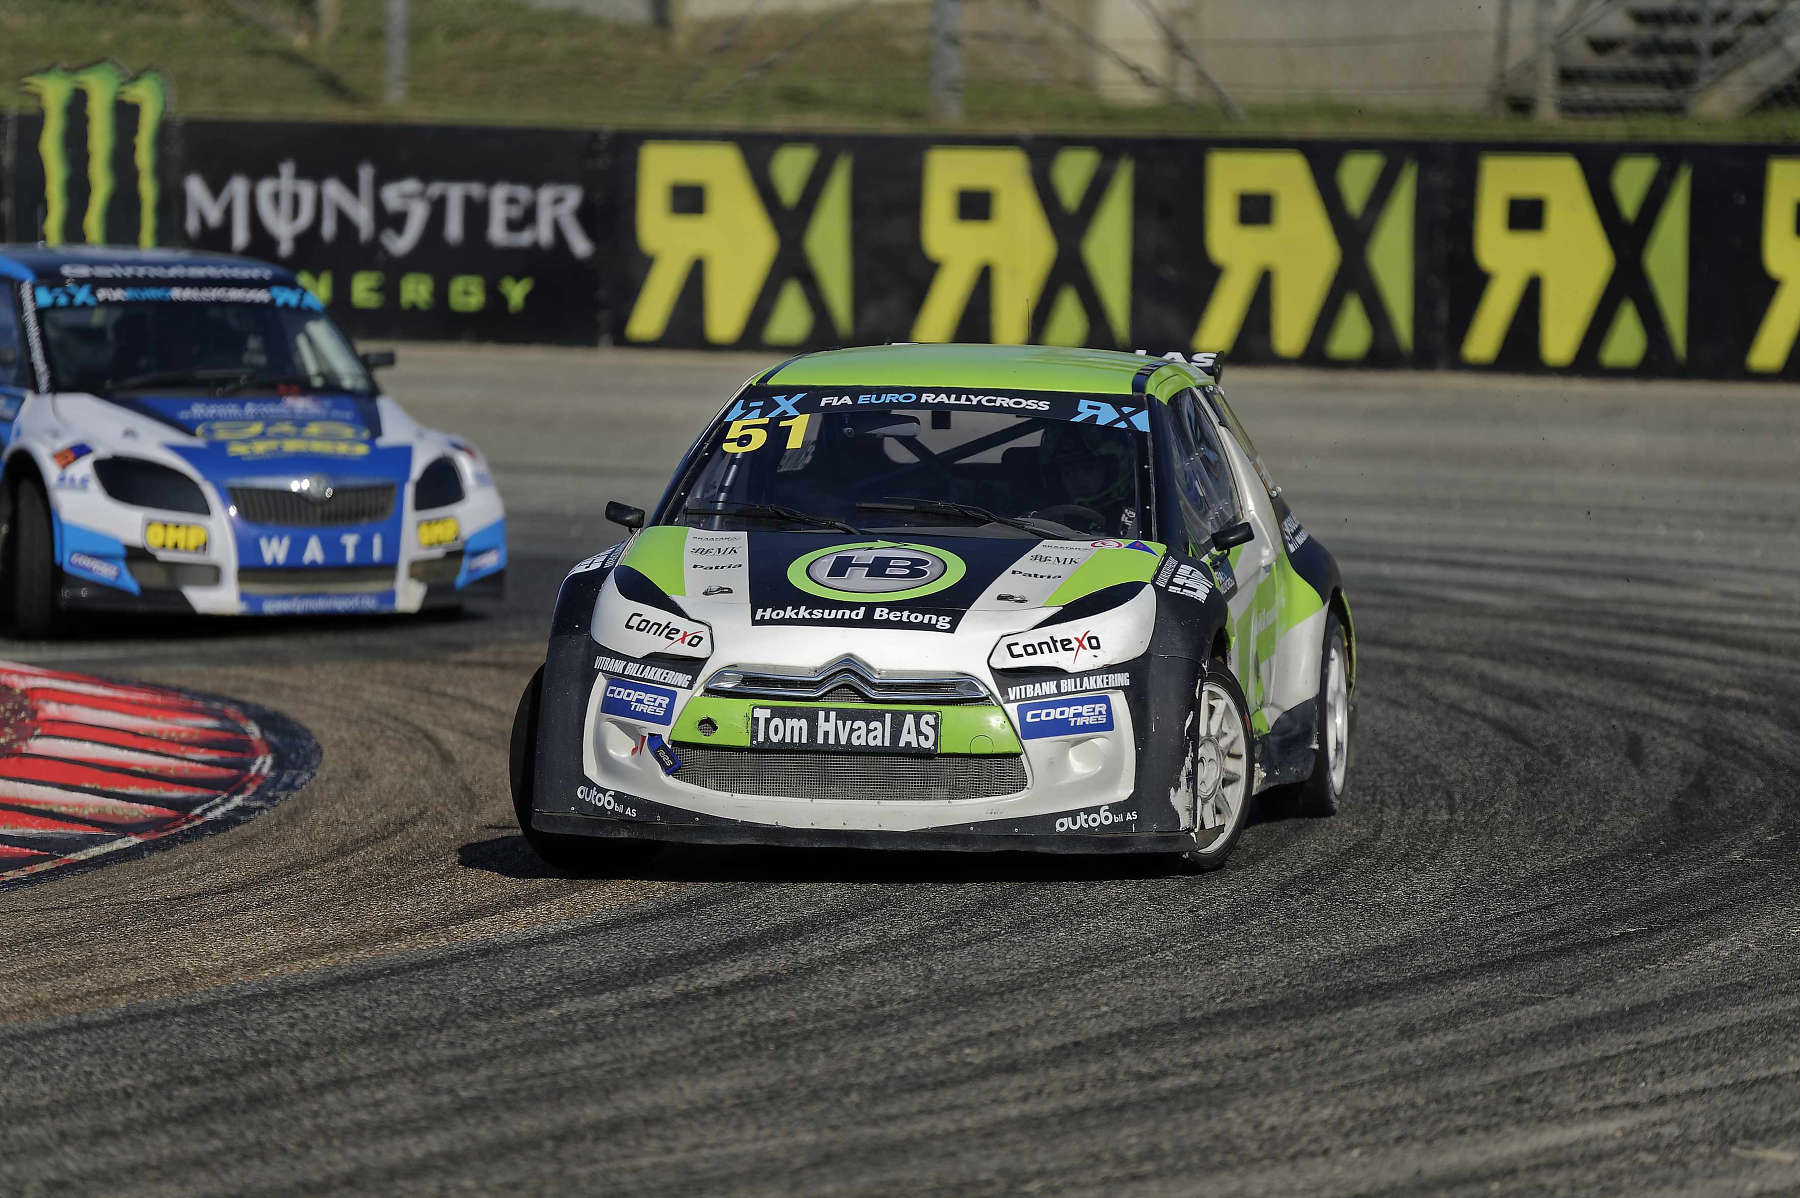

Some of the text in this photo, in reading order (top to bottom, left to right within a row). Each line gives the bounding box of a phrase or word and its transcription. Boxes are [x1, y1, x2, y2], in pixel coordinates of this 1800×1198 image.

[184, 158, 594, 258] MONSTER
[296, 270, 534, 313] NERGY
[820, 396, 853, 407] FIA
[857, 393, 916, 405] EURO
[921, 393, 1051, 411] RALLYCROSS
[721, 413, 811, 454] 51
[145, 521, 208, 552] OMP
[259, 532, 384, 565] WATI
[824, 554, 932, 581] HB
[624, 611, 705, 649] Contexo
[755, 605, 953, 630] Hokksund Betong
[1006, 630, 1101, 664] Contexo
[606, 685, 670, 709] COOPER
[1008, 680, 1058, 701] VITBANK
[630, 701, 666, 716] TIRES
[1026, 703, 1107, 723] COOPER
[1068, 714, 1107, 727] TIRES
[753, 708, 936, 749] Tom Hvaal AS
[625, 807, 637, 818] AS
[1126, 810, 1138, 821] AS
